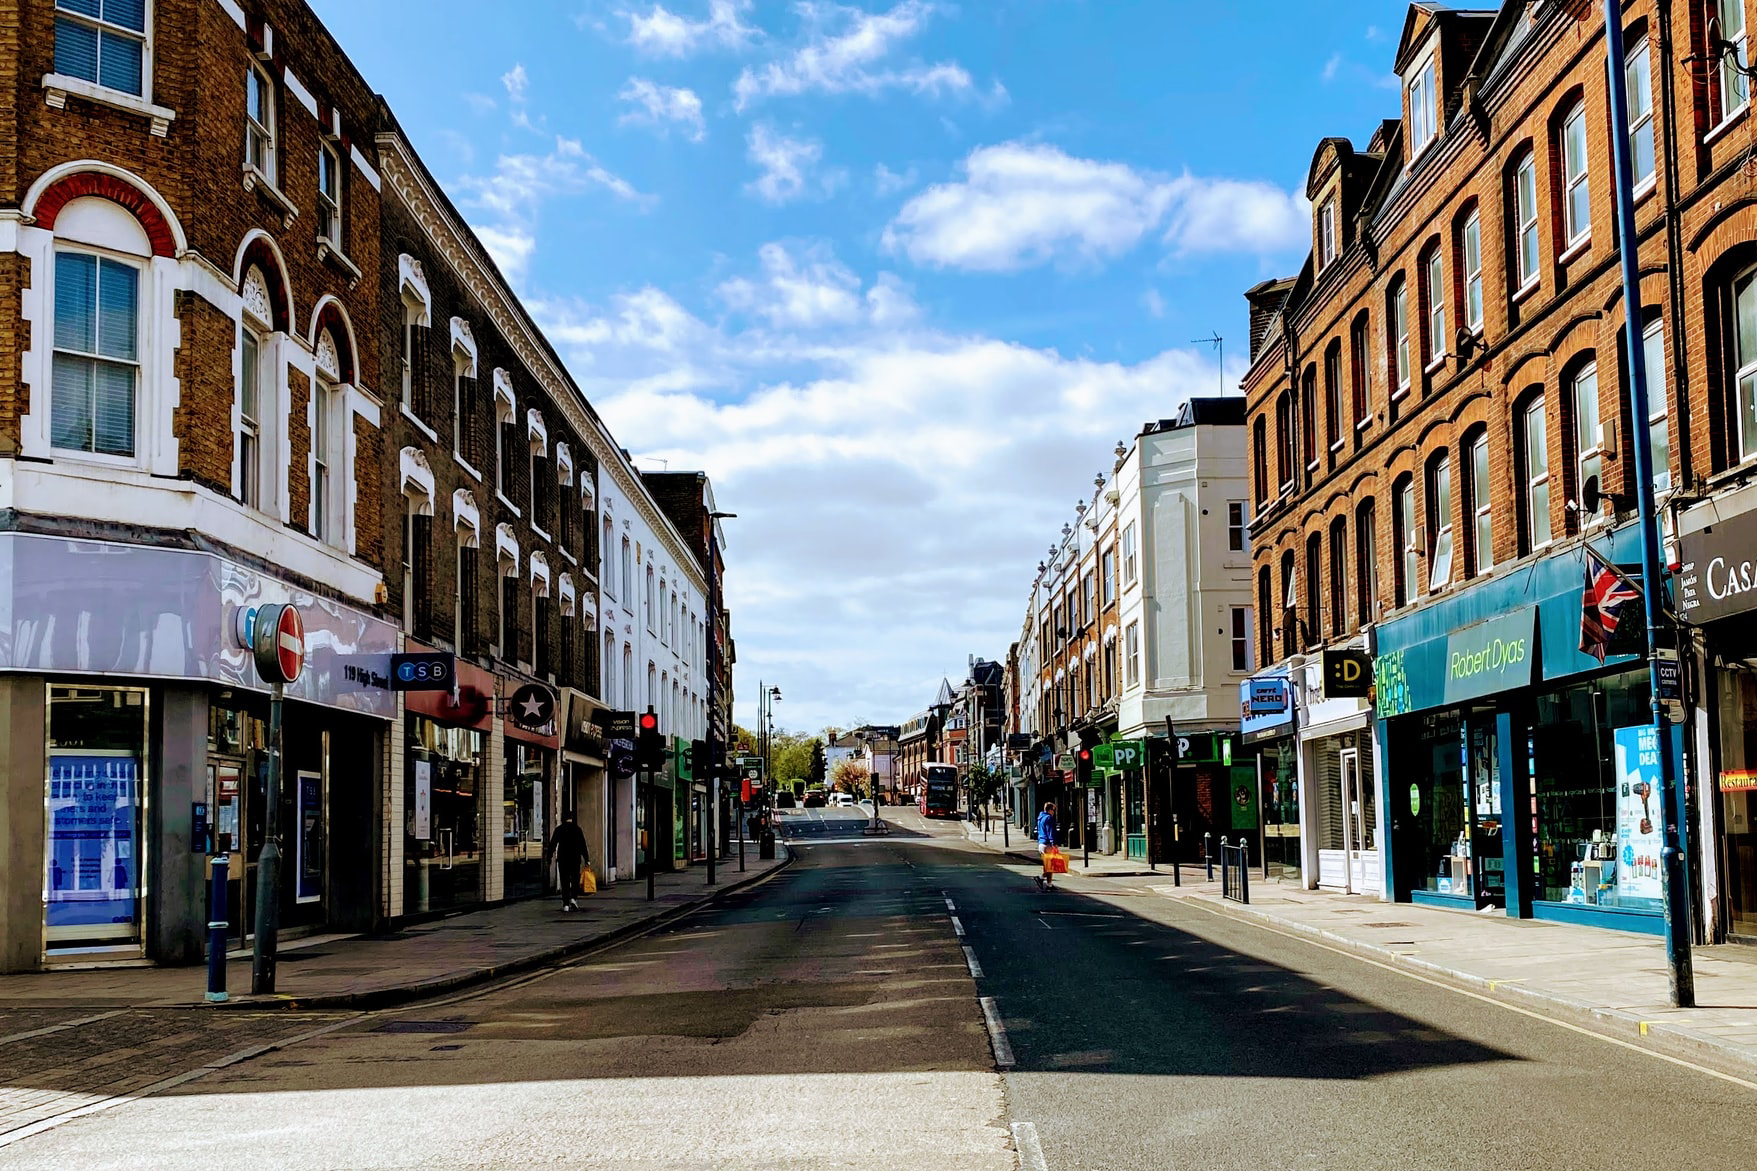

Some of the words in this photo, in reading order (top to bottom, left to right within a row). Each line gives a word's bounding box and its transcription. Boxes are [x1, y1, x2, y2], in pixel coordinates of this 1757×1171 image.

[1706, 557, 1757, 600] CAS
[1450, 641, 1491, 681] Robert
[1492, 638, 1525, 674] Dyas
[344, 664, 356, 681] 119
[357, 667, 371, 688] High
[401, 664, 444, 679] TSB
[1660, 667, 1677, 679] CCTV
[1251, 694, 1283, 703] NERO
[1114, 747, 1136, 766] PP
